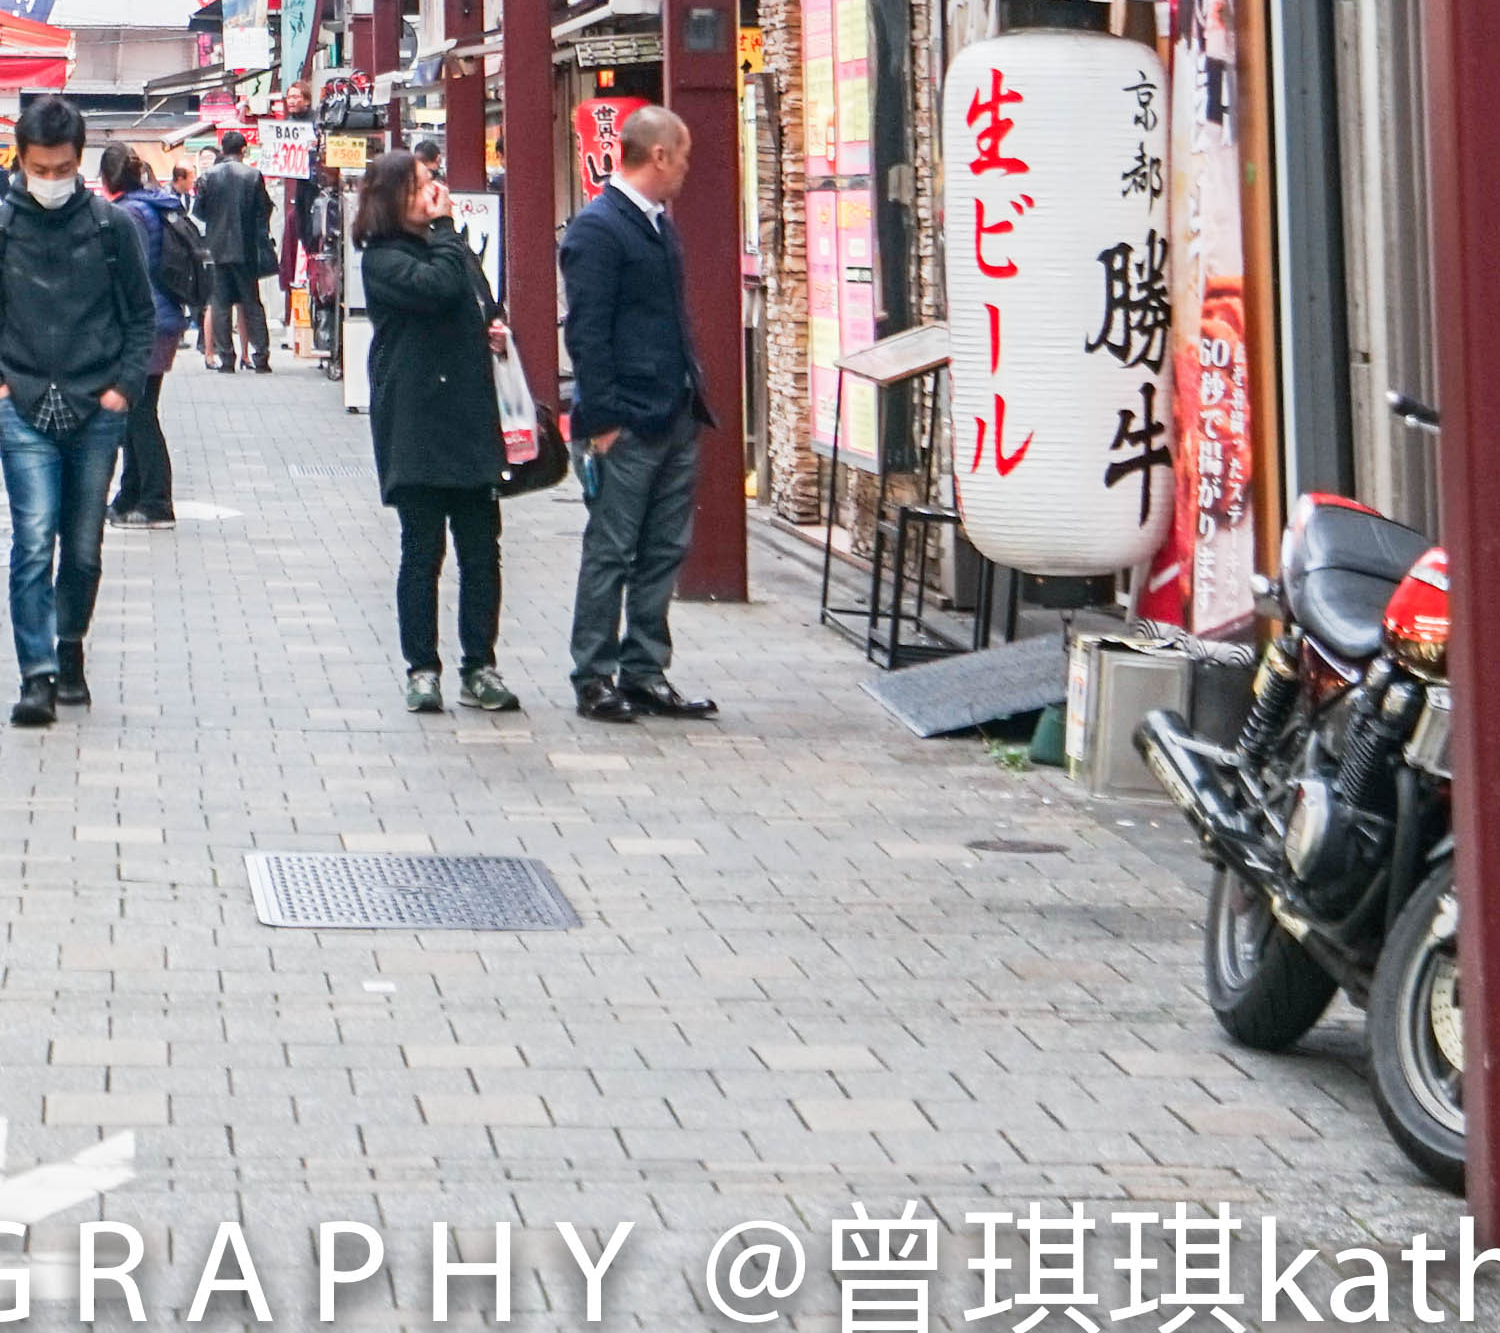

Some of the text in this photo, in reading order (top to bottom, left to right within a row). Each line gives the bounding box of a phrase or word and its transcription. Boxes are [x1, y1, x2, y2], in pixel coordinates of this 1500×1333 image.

[966, 68, 1035, 478] 生ビール
[1085, 228, 1173, 528] 勝牛
